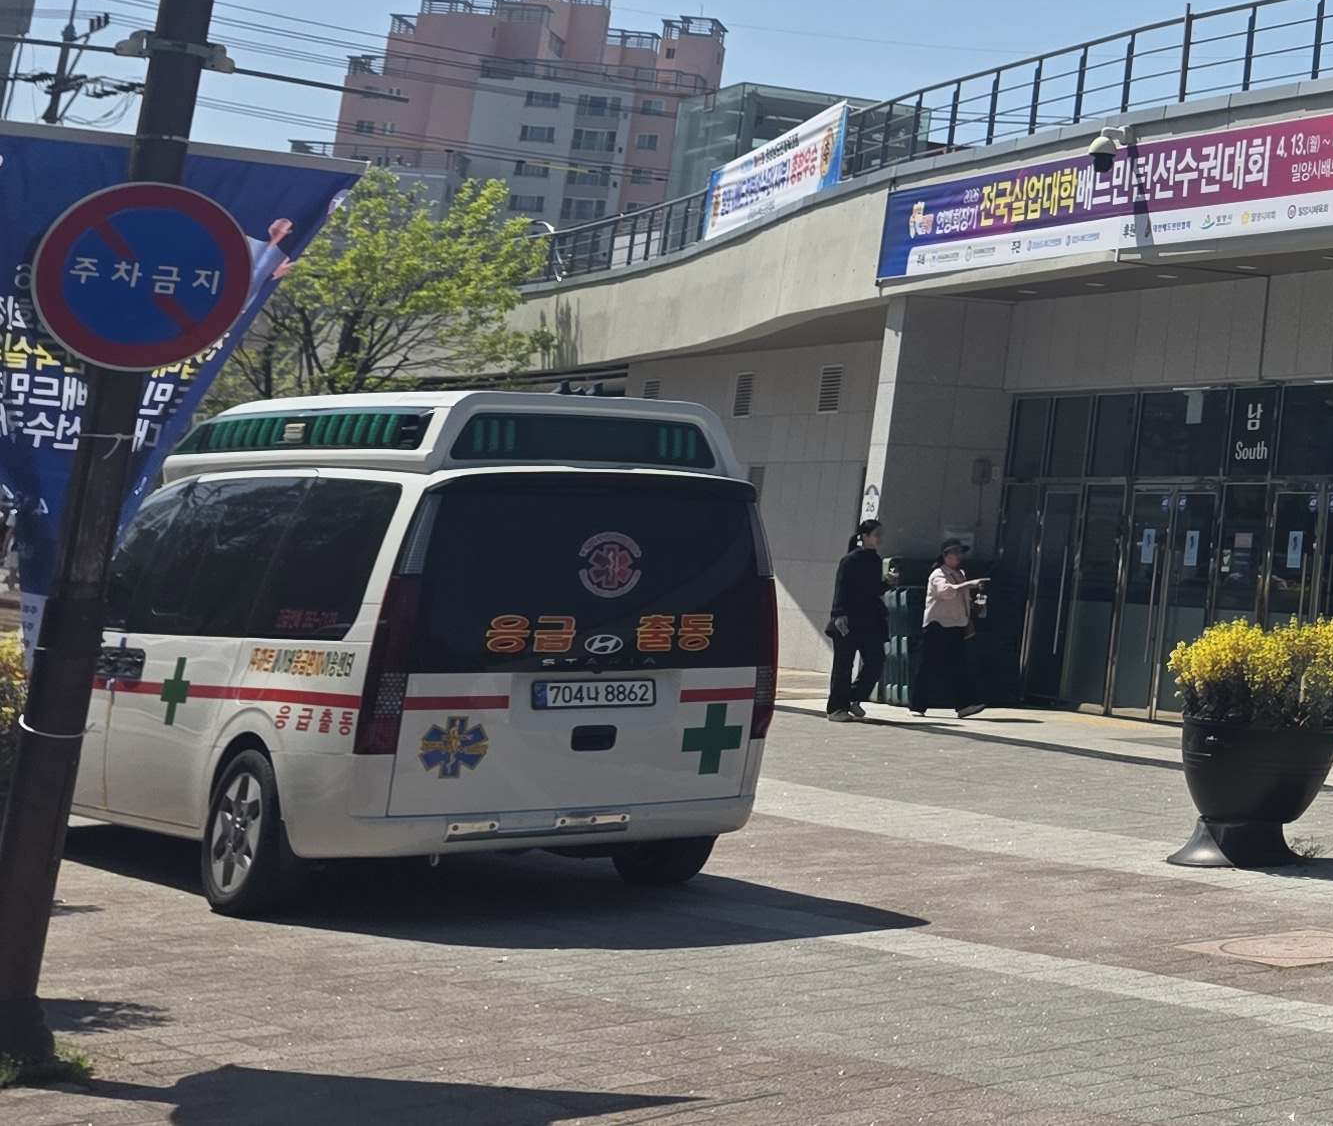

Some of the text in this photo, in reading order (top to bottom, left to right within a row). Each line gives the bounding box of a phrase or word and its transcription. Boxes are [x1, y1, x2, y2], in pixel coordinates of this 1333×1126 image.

[1246, 403, 1264, 431] 남
[1235, 440, 1268, 462] South
[865, 501, 875, 512] 26
[485, 614, 714, 653] 응급 출동
[542, 656, 656, 667] STARIA
